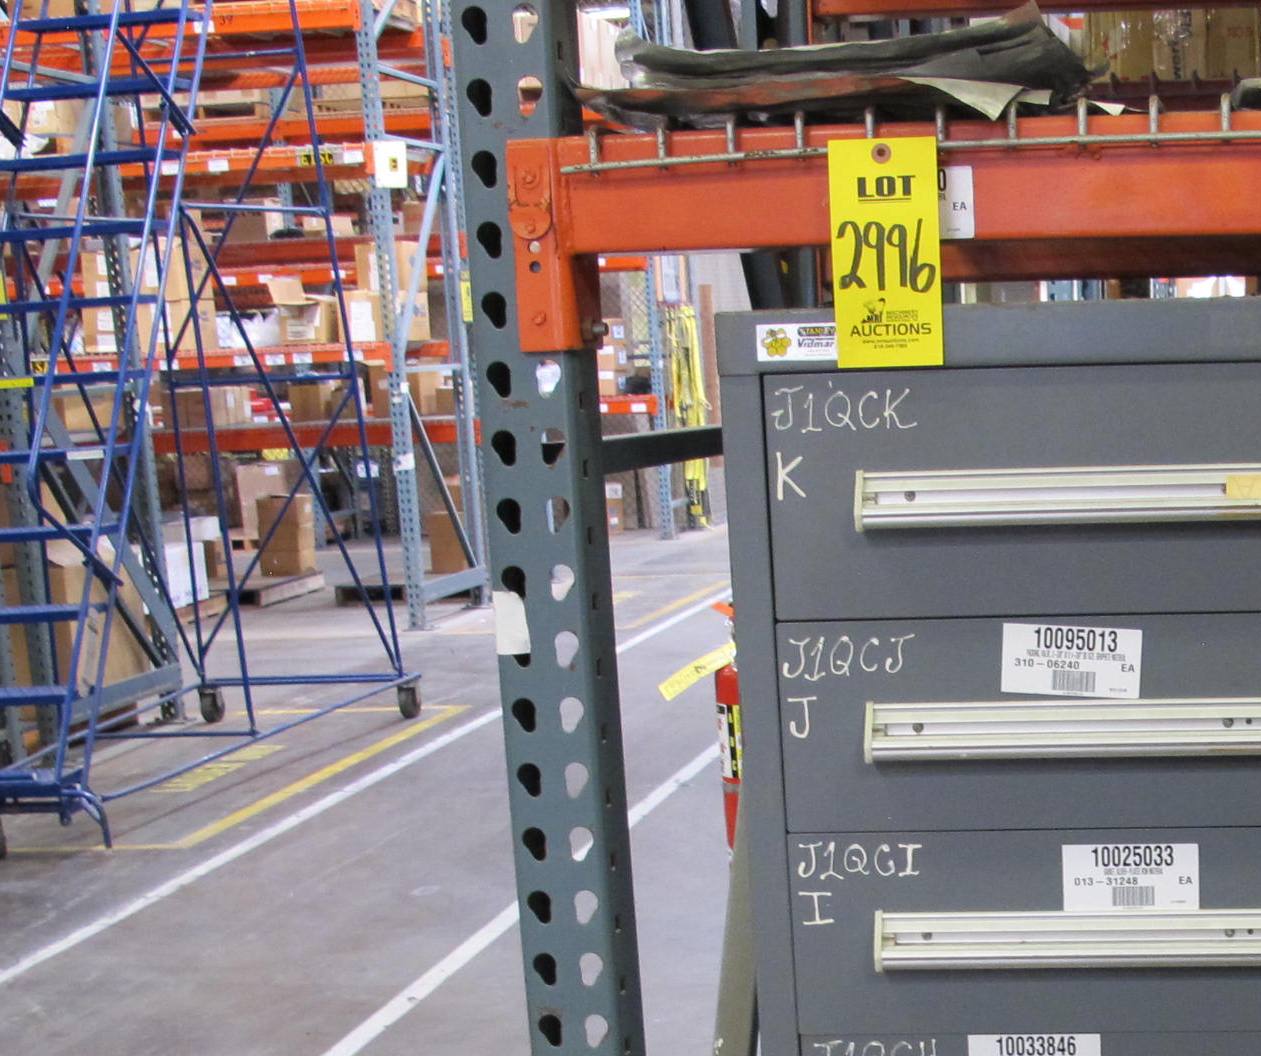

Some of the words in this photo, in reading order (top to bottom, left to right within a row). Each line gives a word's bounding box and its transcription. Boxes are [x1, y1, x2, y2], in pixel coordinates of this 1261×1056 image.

[857, 175, 916, 198] LOT
[953, 201, 967, 211] EA
[836, 218, 936, 293] 2996
[850, 322, 932, 337] AUCTIONS
[771, 385, 918, 433] J1QCK
[775, 451, 807, 501] K
[1034, 627, 1119, 653] 10095013
[782, 633, 916, 682] J1QCJ
[1121, 663, 1136, 673] EA
[786, 696, 817, 739] J
[1091, 845, 1174, 867] 10025033
[1178, 876, 1193, 885] EA
[995, 1036, 1076, 1056] 10033846
